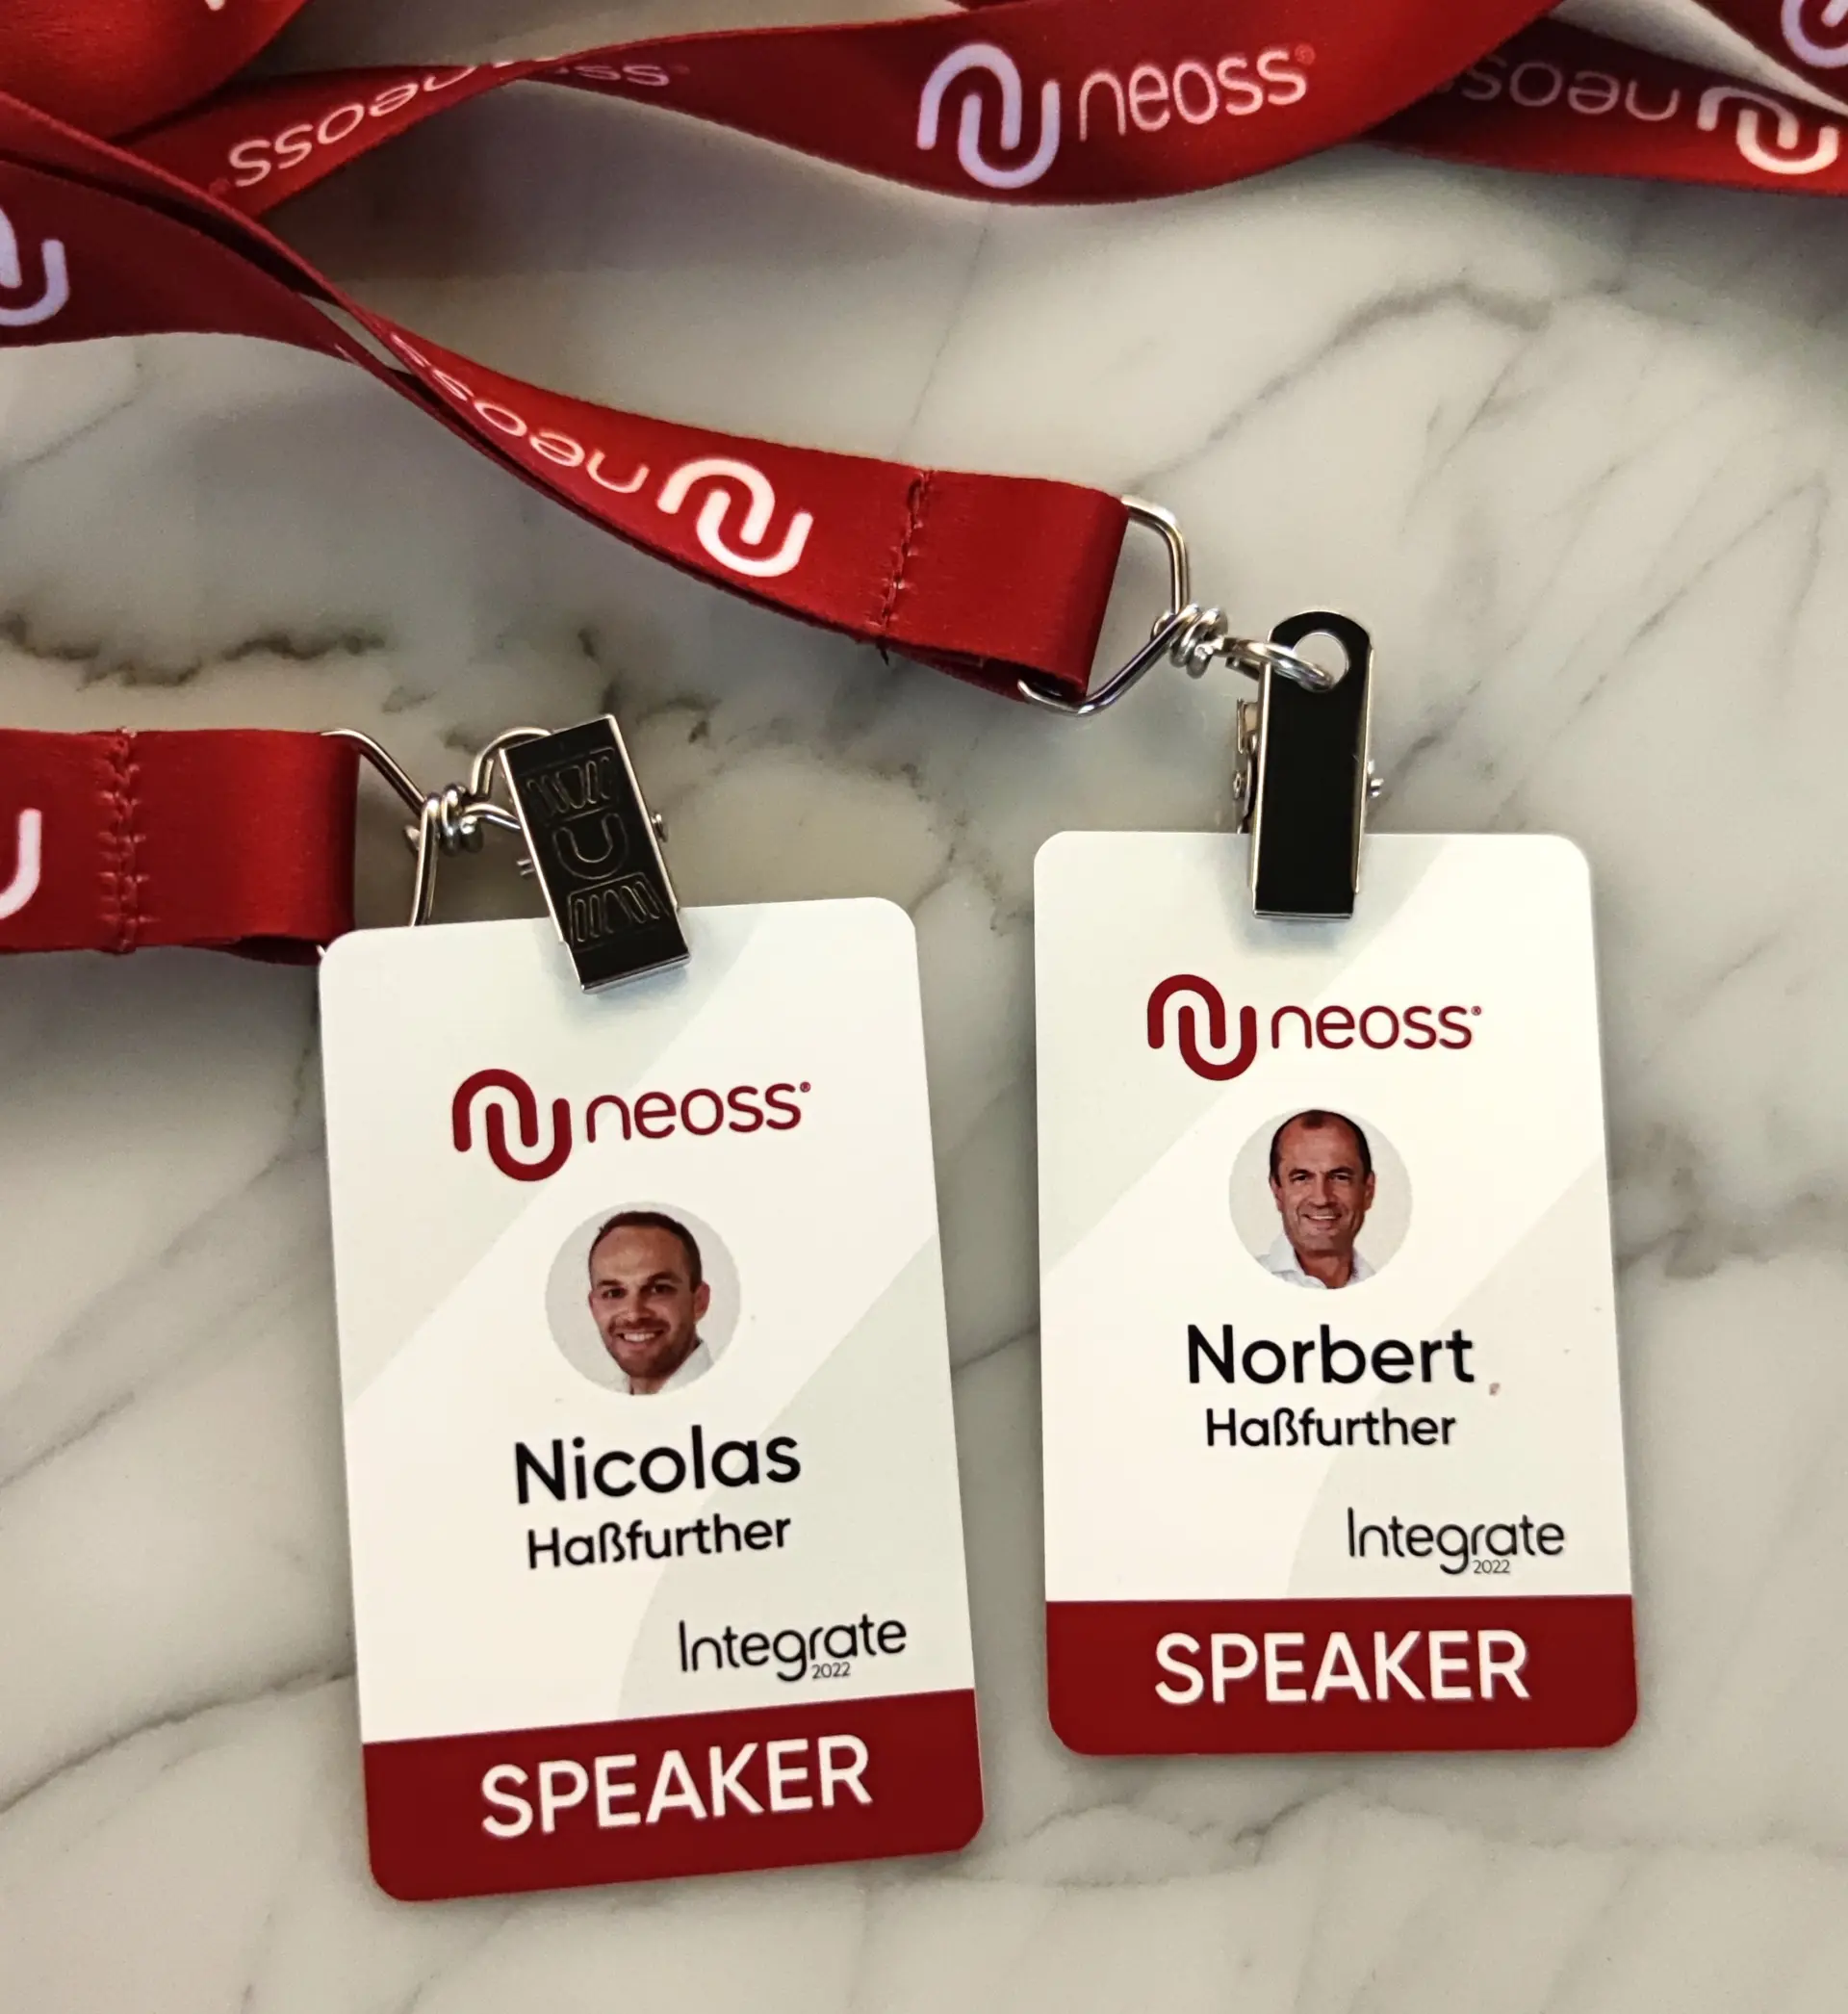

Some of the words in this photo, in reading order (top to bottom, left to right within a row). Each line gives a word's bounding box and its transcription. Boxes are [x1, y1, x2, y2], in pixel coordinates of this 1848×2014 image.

[1435, 54, 1681, 121] neos
[1187, 1323, 1476, 1384] Norbert
[1205, 1407, 1457, 1447] Haßfurther
[514, 1424, 802, 1505] Nicolas
[526, 1512, 791, 1570] Haßfurther
[1347, 1507, 1566, 1575] Integrate
[1473, 1559, 1512, 1575] 2022
[679, 1613, 908, 1683] Integrate
[810, 1661, 852, 1680] 2022
[1154, 1629, 1532, 1706] SPEAKER
[480, 1733, 873, 1840] SPEAKER
